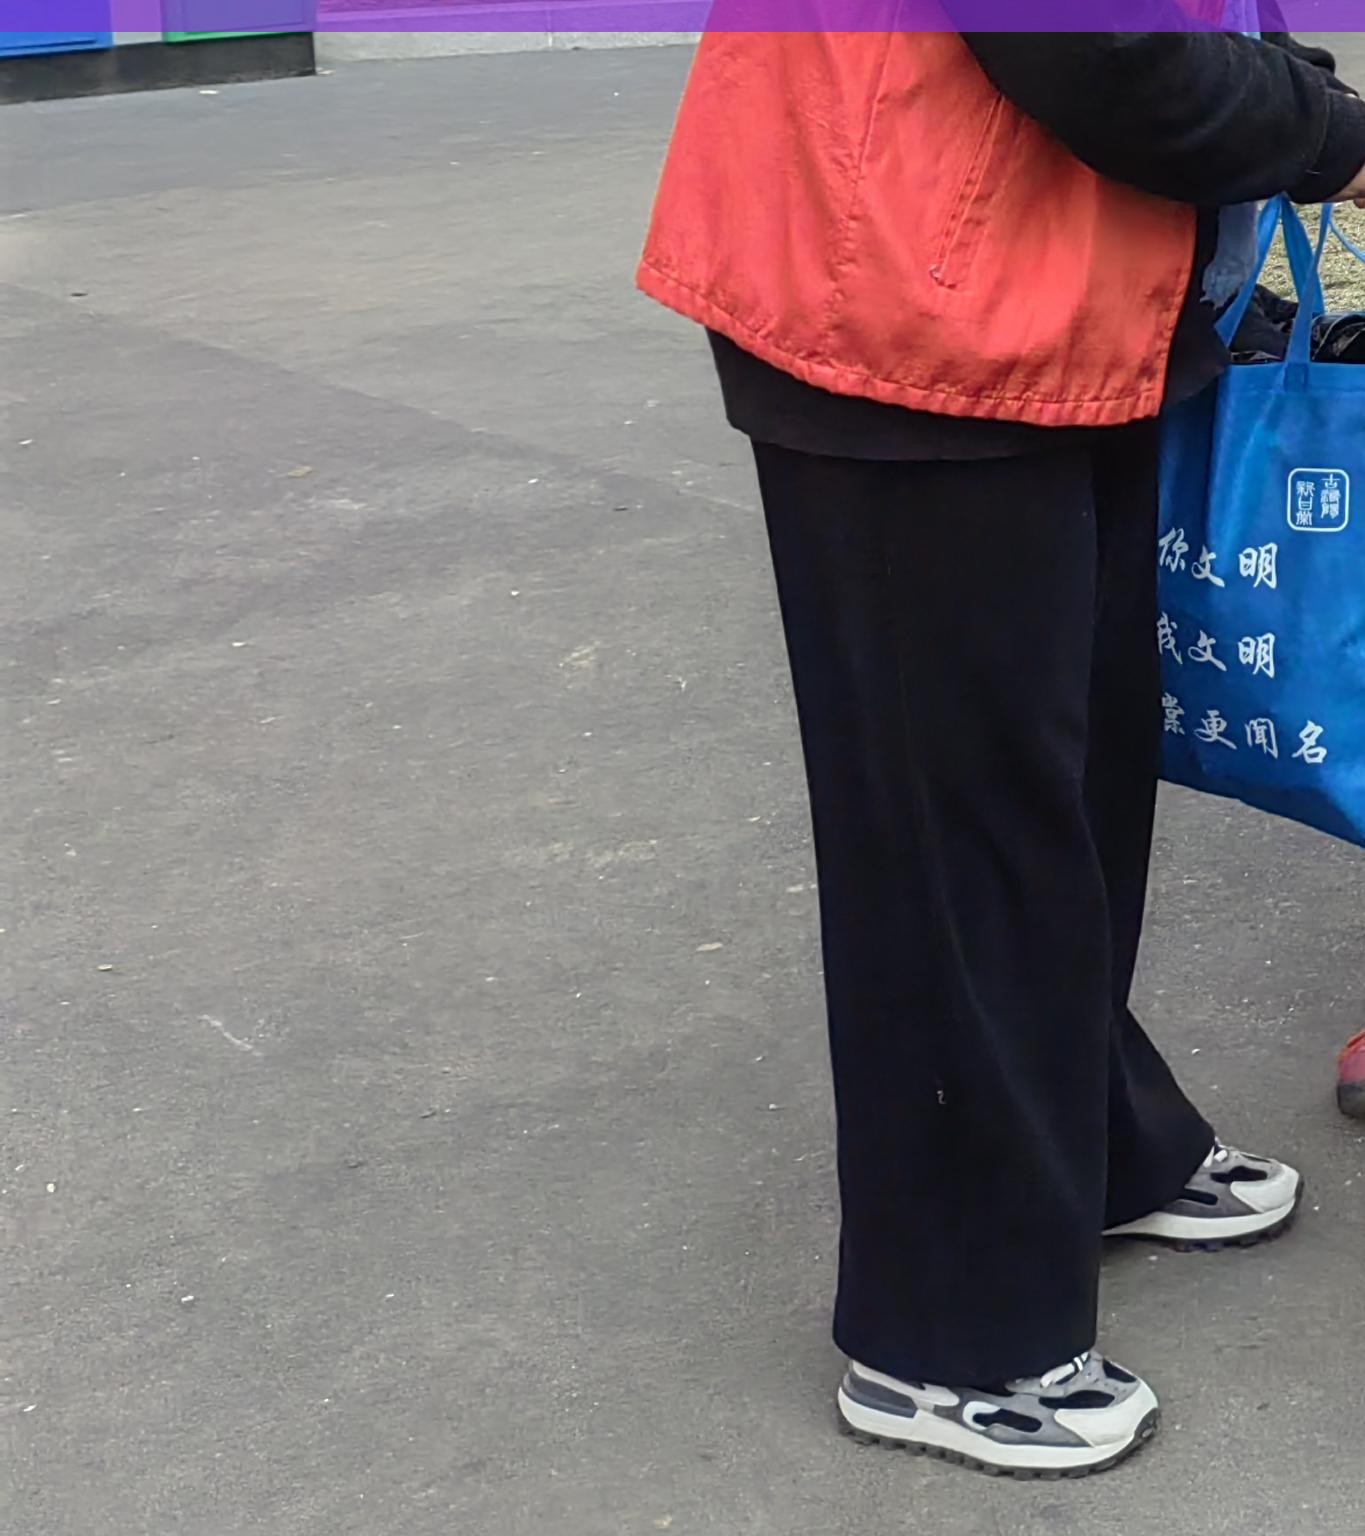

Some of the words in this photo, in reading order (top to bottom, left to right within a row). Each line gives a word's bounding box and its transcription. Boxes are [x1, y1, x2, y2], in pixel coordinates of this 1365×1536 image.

[1158, 527, 1278, 589] 你文明
[1157, 610, 1277, 679] 我文明
